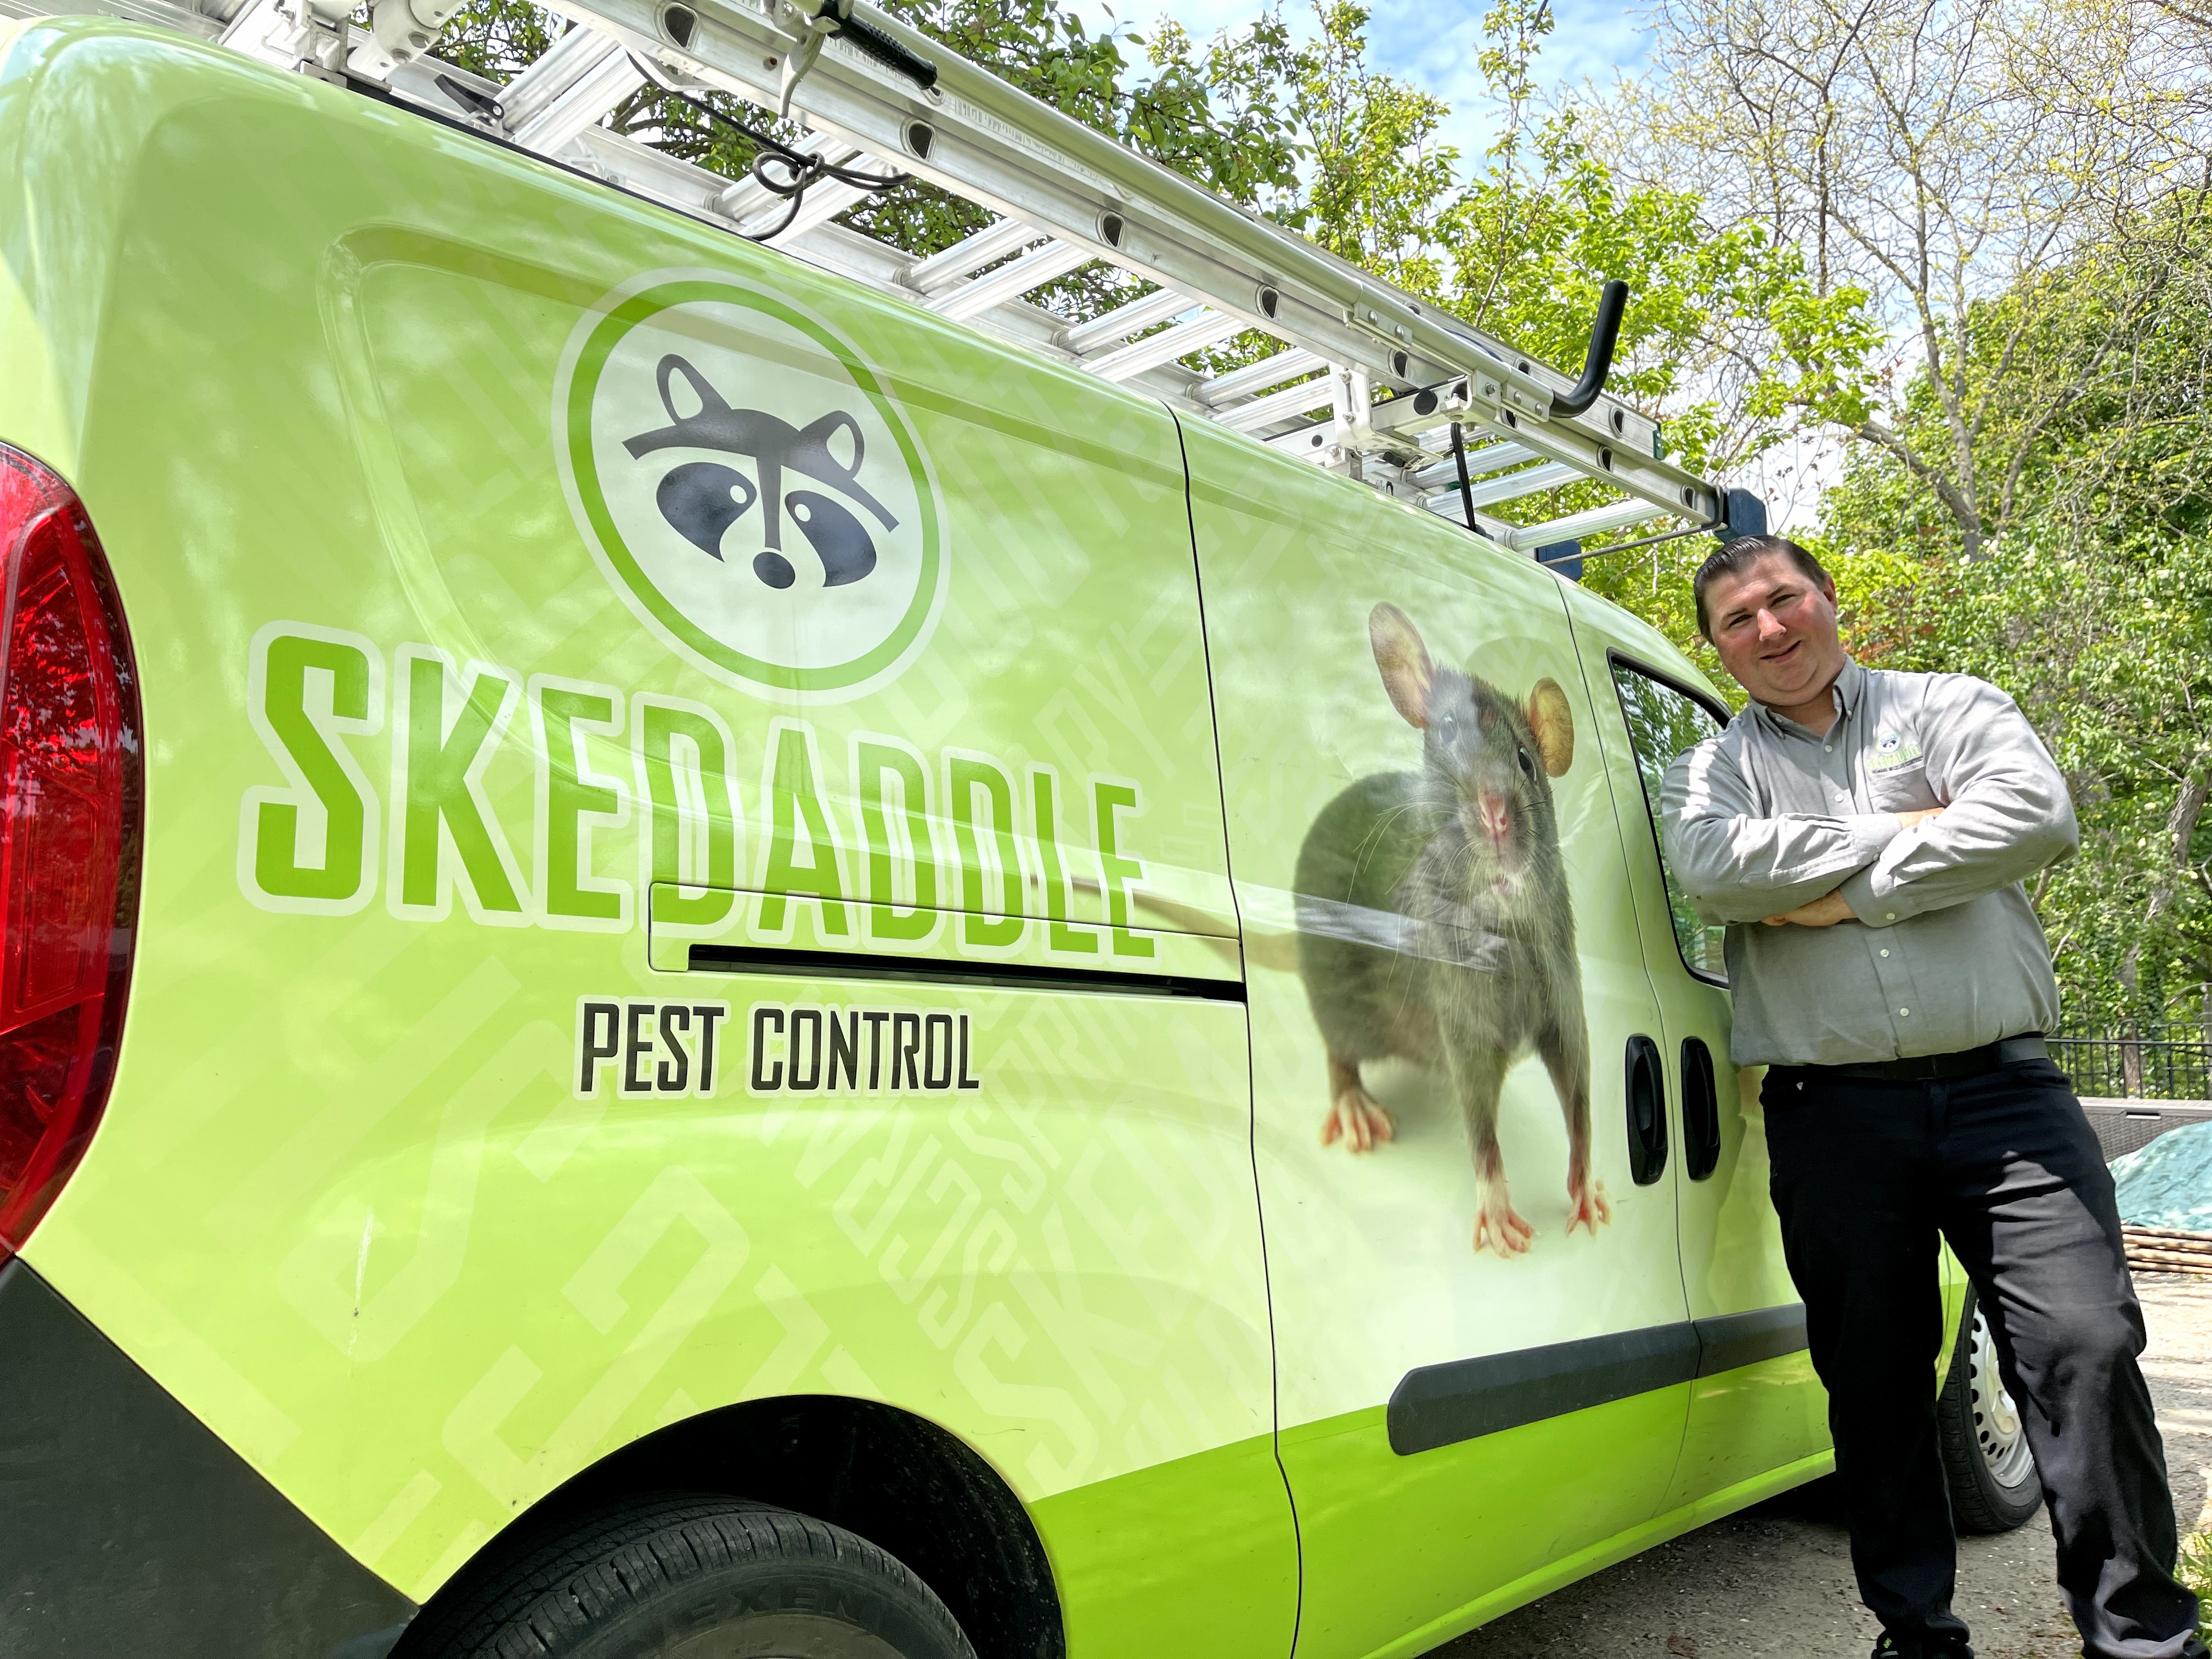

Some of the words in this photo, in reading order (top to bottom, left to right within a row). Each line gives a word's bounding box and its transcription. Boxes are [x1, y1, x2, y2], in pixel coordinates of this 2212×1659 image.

[255, 634, 1156, 958] SKEDADDLE
[1866, 743, 1923, 770] SKEDADDLE
[579, 1002, 725, 1092] PEST
[751, 1008, 980, 1091] CONTROL
